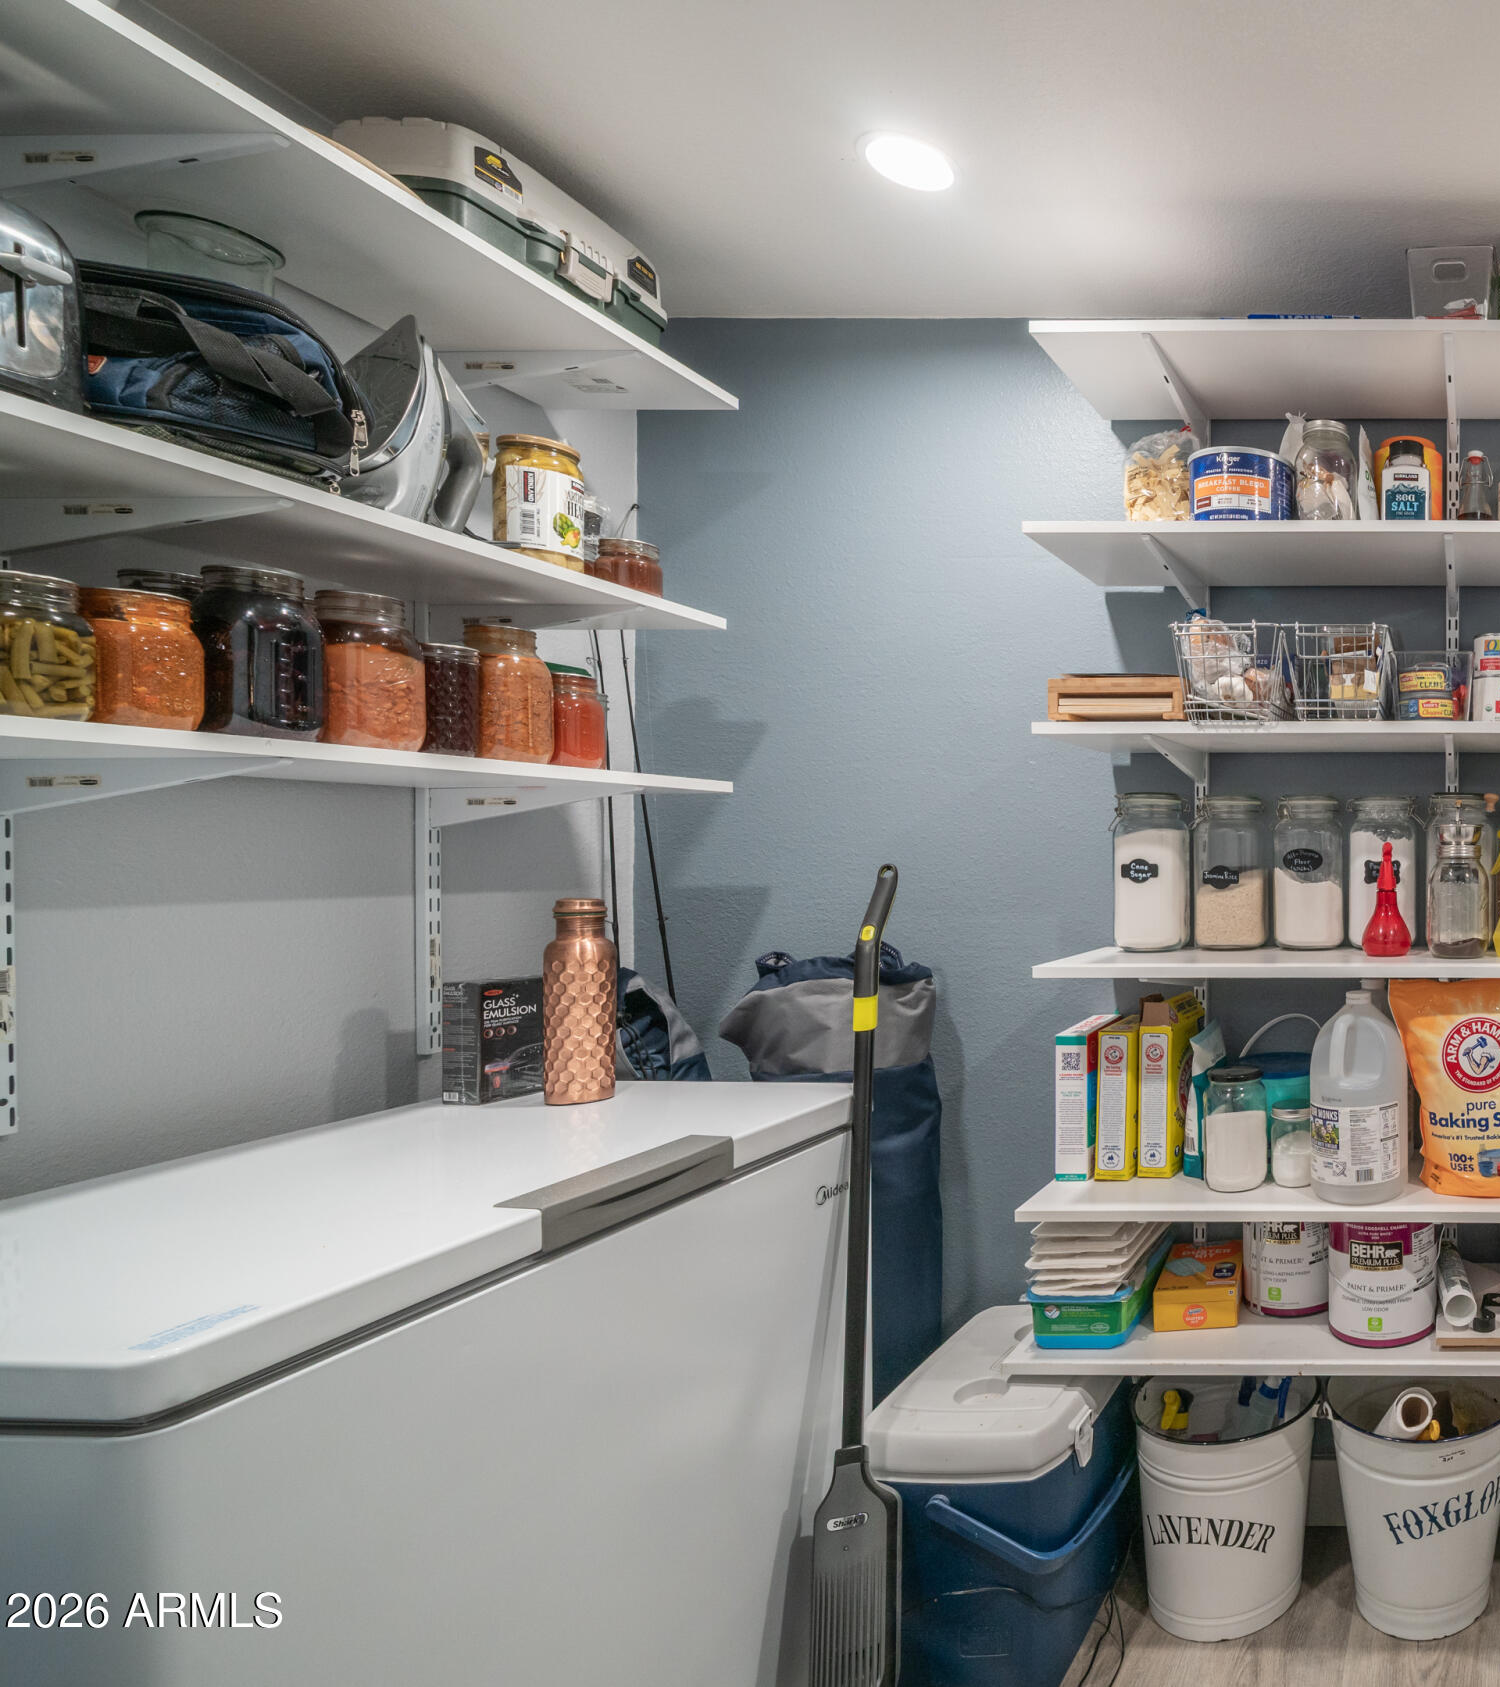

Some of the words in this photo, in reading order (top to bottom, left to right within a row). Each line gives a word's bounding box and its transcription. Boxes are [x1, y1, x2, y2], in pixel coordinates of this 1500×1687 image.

[1216, 453, 1241, 466] Kroger
[527, 472, 535, 502] KIRKLAND
[1197, 478, 1237, 489] BREAKFAST
[1239, 479, 1265, 489] BLEND
[1395, 493, 1416, 502] sea
[1391, 502, 1420, 512] SALT
[1419, 681, 1444, 689] CLAMS
[1130, 862, 1149, 871] Cane
[1129, 870, 1153, 881] Sugar
[1203, 871, 1224, 880] Jasmine
[1224, 871, 1238, 880] Rice
[483, 997, 516, 1010] GLASS
[483, 1004, 537, 1020] EMULSION
[1446, 1033, 1463, 1064] ARM
[1460, 1026, 1472, 1038] &
[1461, 1077, 1486, 1086] STANDARD
[1466, 1100, 1497, 1115] pure
[1317, 1107, 1339, 1120] MONKS
[1428, 1111, 1490, 1133] Baking
[1431, 1132, 1455, 1141] America's
[1448, 1152, 1475, 1163] 100+
[1450, 1163, 1475, 1172] USES
[815, 1181, 849, 1206] Midea
[1351, 1243, 1385, 1259] BEHR
[1275, 1257, 1302, 1265] PRIMER
[1351, 1257, 1382, 1266] PREMIUM
[1383, 1258, 1400, 1266] PLUS
[1346, 1282, 1367, 1293] PAINT
[1376, 1284, 1406, 1293] PRIMER
[832, 1516, 858, 1529] Shark
[1146, 1513, 1276, 1554] LAVENDER
